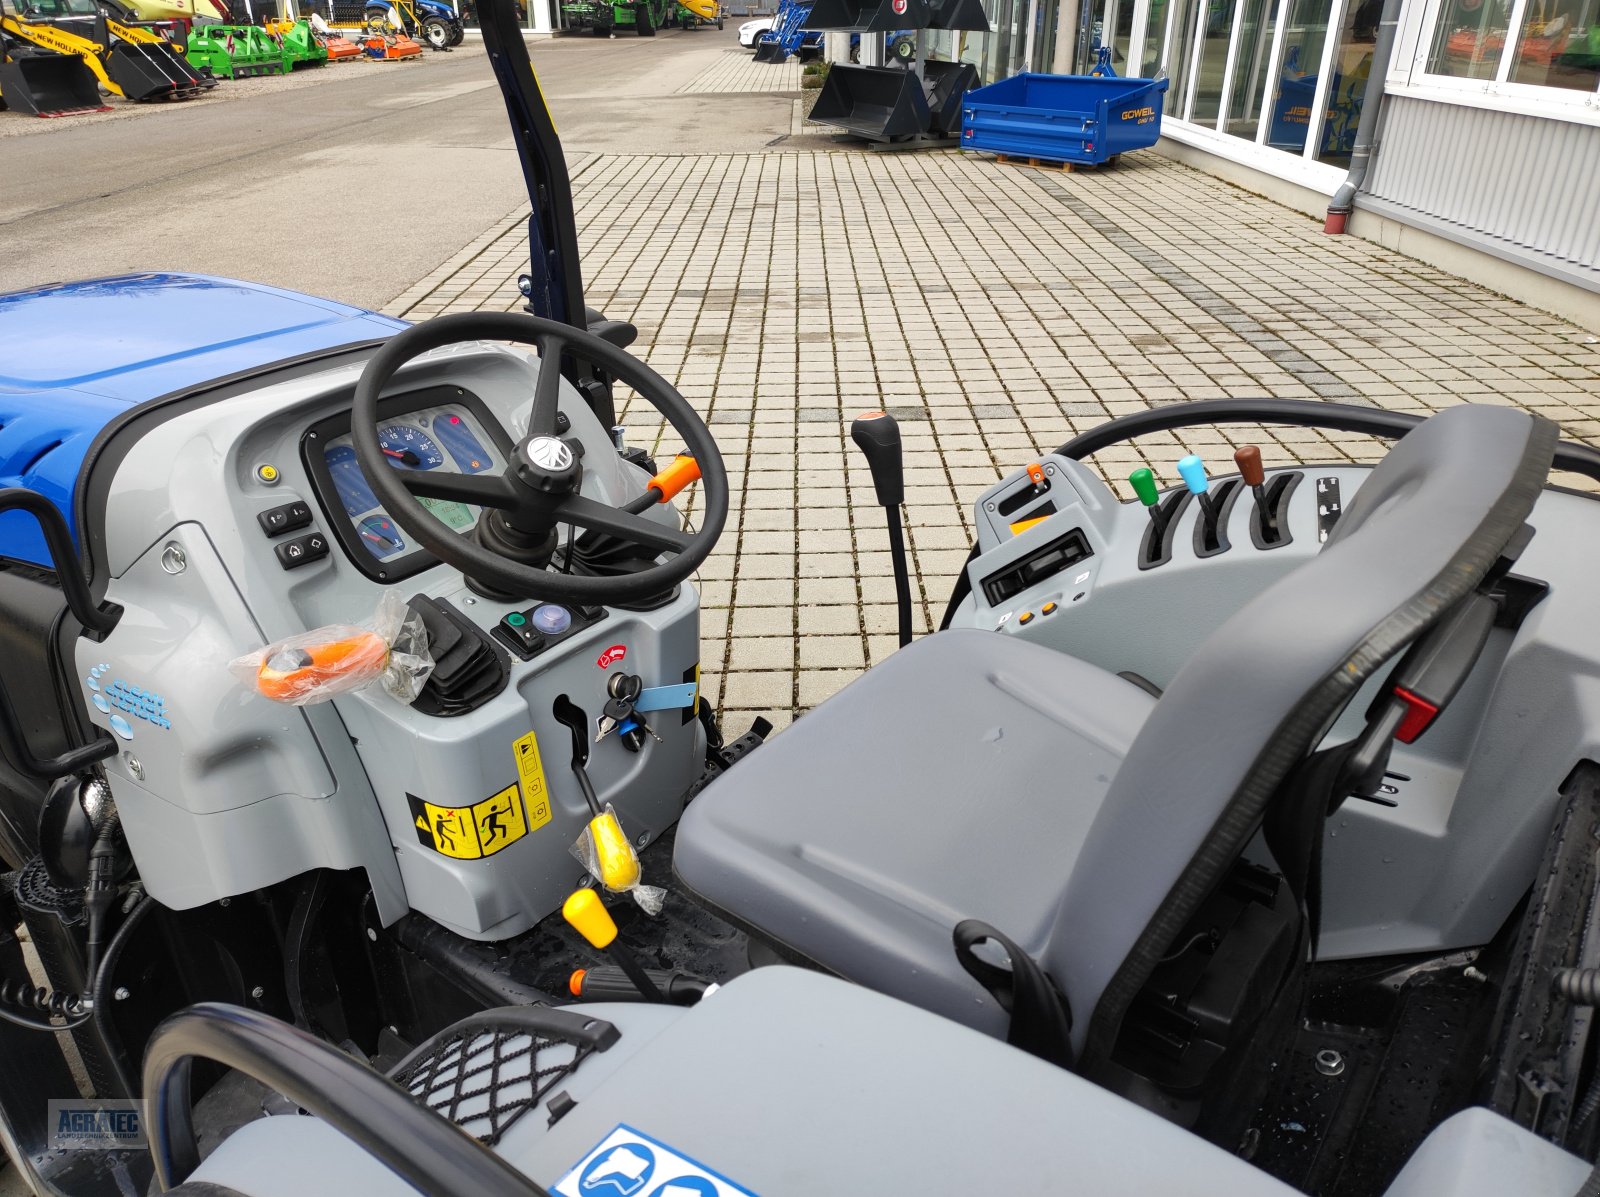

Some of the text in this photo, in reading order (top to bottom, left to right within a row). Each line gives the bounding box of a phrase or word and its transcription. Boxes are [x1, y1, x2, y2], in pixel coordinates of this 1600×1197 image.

[113, 25, 129, 37] NEW
[37, 33, 89, 60] NEW HOLLAND
[405, 433, 414, 441] 20
[113, 679, 165, 707] CLEAN
[111, 697, 171, 730] LEADER
